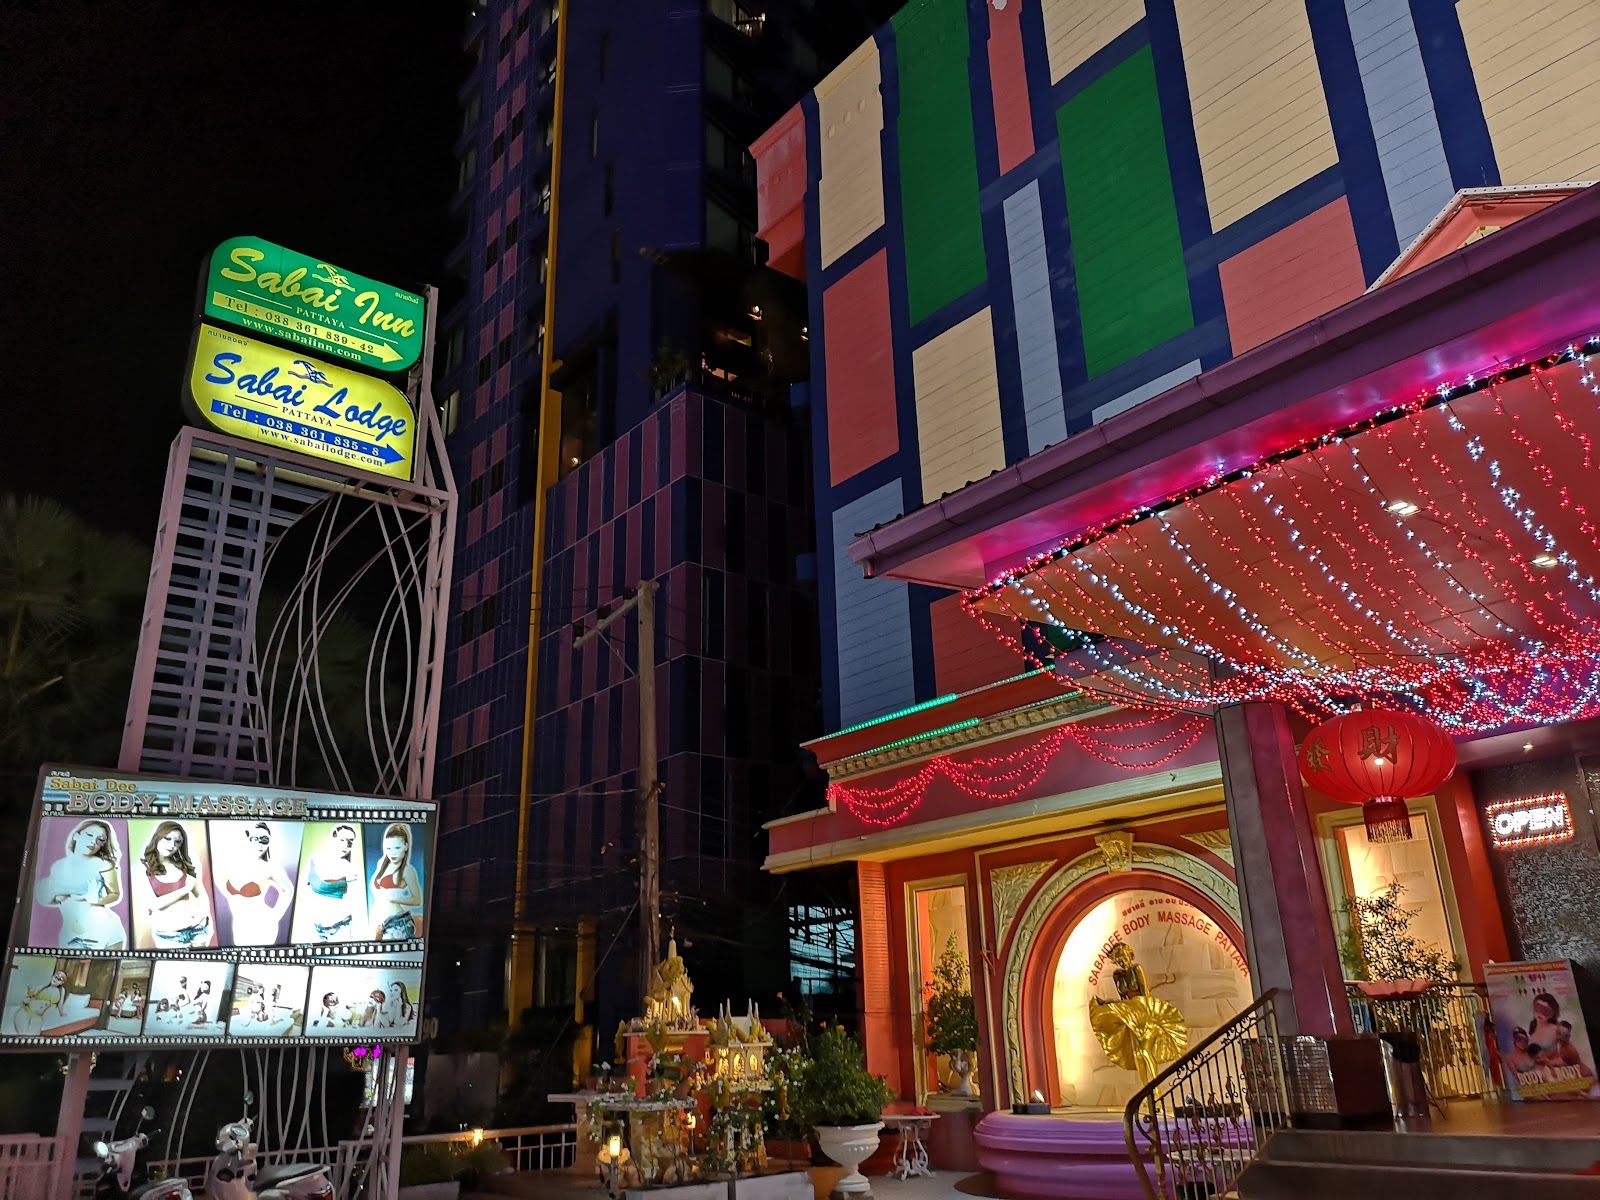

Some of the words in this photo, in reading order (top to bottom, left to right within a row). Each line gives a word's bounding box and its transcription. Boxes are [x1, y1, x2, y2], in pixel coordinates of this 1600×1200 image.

[221, 248, 341, 312] Sabai
[354, 291, 415, 337] Inn
[225, 296, 248, 312] Tel
[265, 312, 289, 326] 038
[296, 321, 319, 336] 361
[297, 307, 345, 329] PATTAYA
[243, 317, 362, 361] www.sabaiinn.com
[205, 352, 308, 406] Sabai
[313, 387, 407, 442] Lodge
[221, 403, 247, 420] Tel
[266, 417, 293, 432] 038
[301, 426, 326, 442] 361
[282, 406, 333, 427] PATTAYA
[260, 428, 383, 467] www.sabailodge.com
[49, 777, 99, 792] Sabai
[104, 778, 138, 793] Dee
[66, 791, 157, 813] BODY
[168, 793, 308, 816] MASSAGE
[1494, 805, 1566, 836] OPEN
[1123, 914, 1150, 936] BODY
[1157, 911, 1212, 936] MASSAGE
